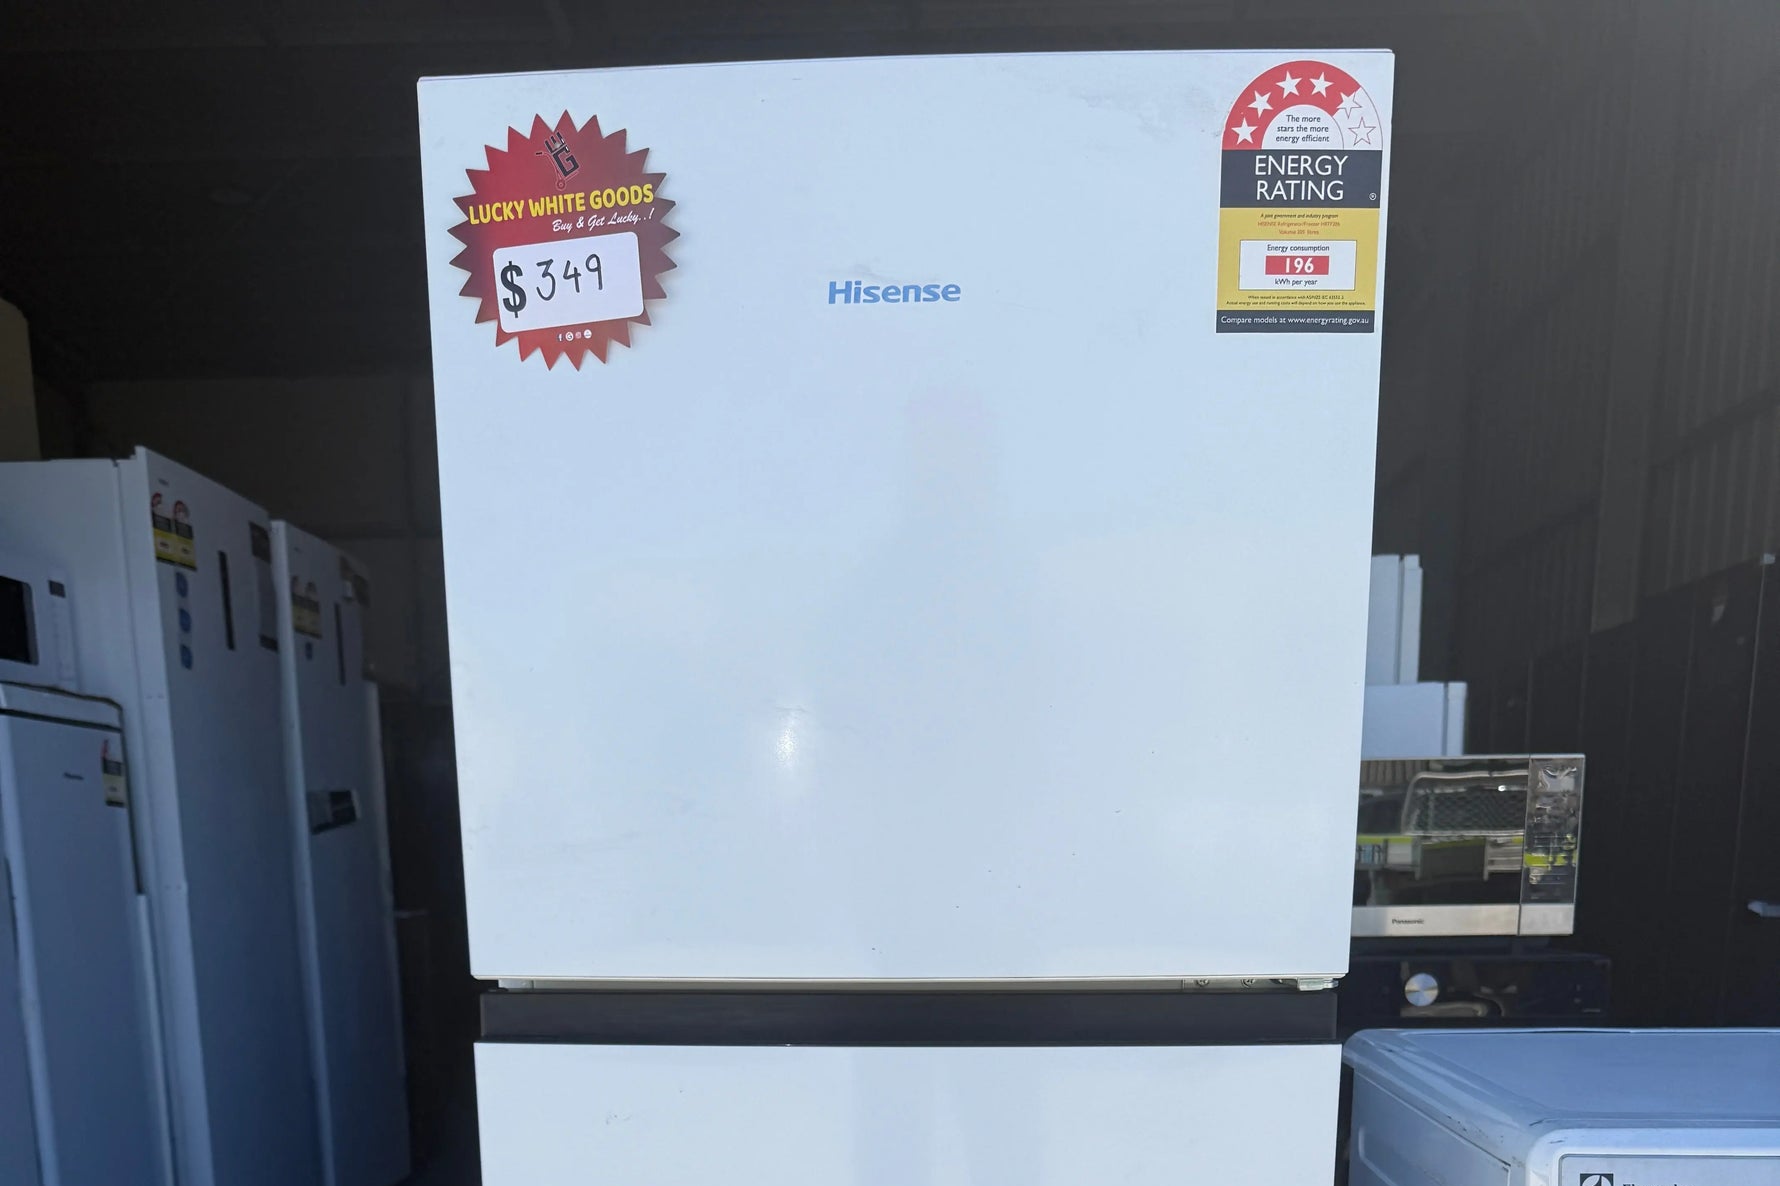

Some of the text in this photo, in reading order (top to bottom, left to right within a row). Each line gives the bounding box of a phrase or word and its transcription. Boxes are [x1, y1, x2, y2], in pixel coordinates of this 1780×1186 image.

[1276, 136, 1300, 144] energy
[1255, 155, 1348, 175] ENERGY
[1256, 180, 1344, 201] RATING
[468, 184, 654, 225] LUCKY WHITE GOODS
[552, 219, 573, 233] Buy
[576, 216, 584, 228] &
[588, 216, 605, 227] Get
[1267, 244, 1288, 252] Energy
[1285, 258, 1314, 273] 196
[828, 280, 961, 304] Hisense
[1221, 316, 1252, 325] Compare
[1288, 317, 1369, 325] www.energyrating.gov.au
